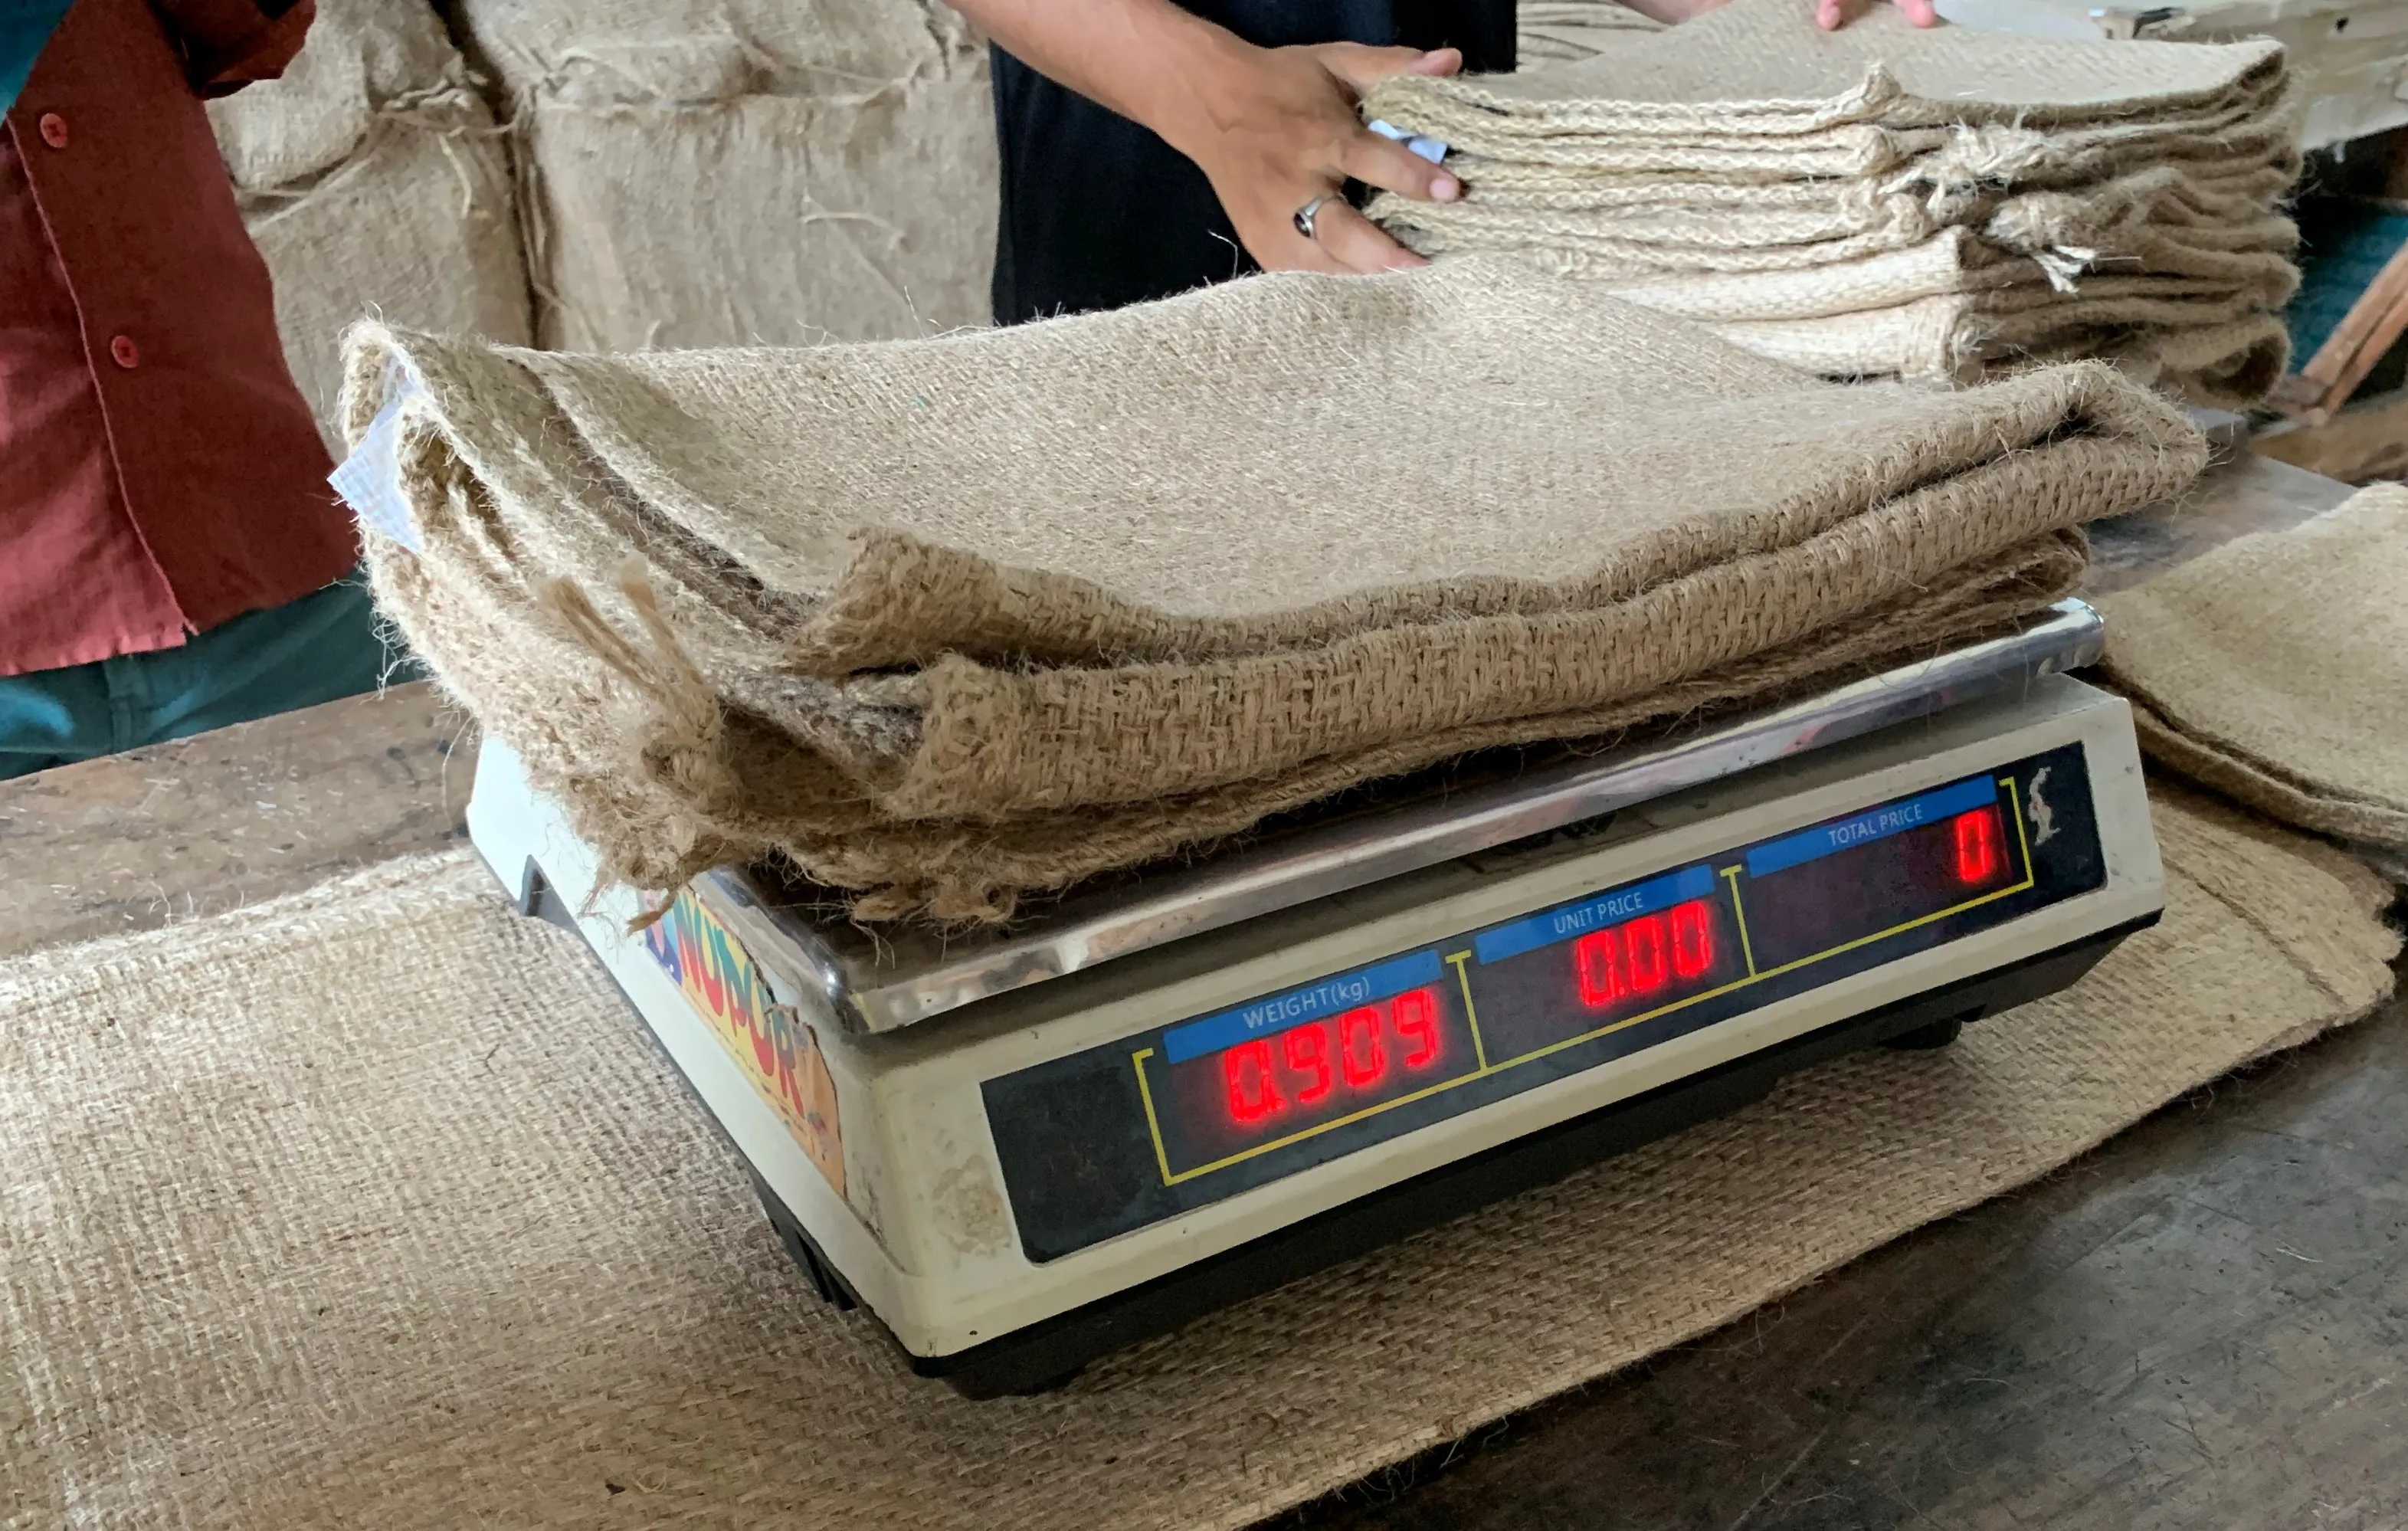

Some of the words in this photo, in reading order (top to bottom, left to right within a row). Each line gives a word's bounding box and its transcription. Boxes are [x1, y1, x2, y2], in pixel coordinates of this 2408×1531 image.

[1828, 815, 1877, 847] TOTAL
[1879, 804, 1923, 831] PRICE
[1956, 809, 1990, 882] 0
[1554, 907, 1594, 934] UNIT
[1597, 891, 1643, 920] PRICE
[1577, 901, 1712, 1006] 0.00
[673, 891, 806, 1120] NUPUR
[1242, 975, 1371, 1029] WEIGHT(kg)
[1225, 988, 1437, 1122] 0.909
